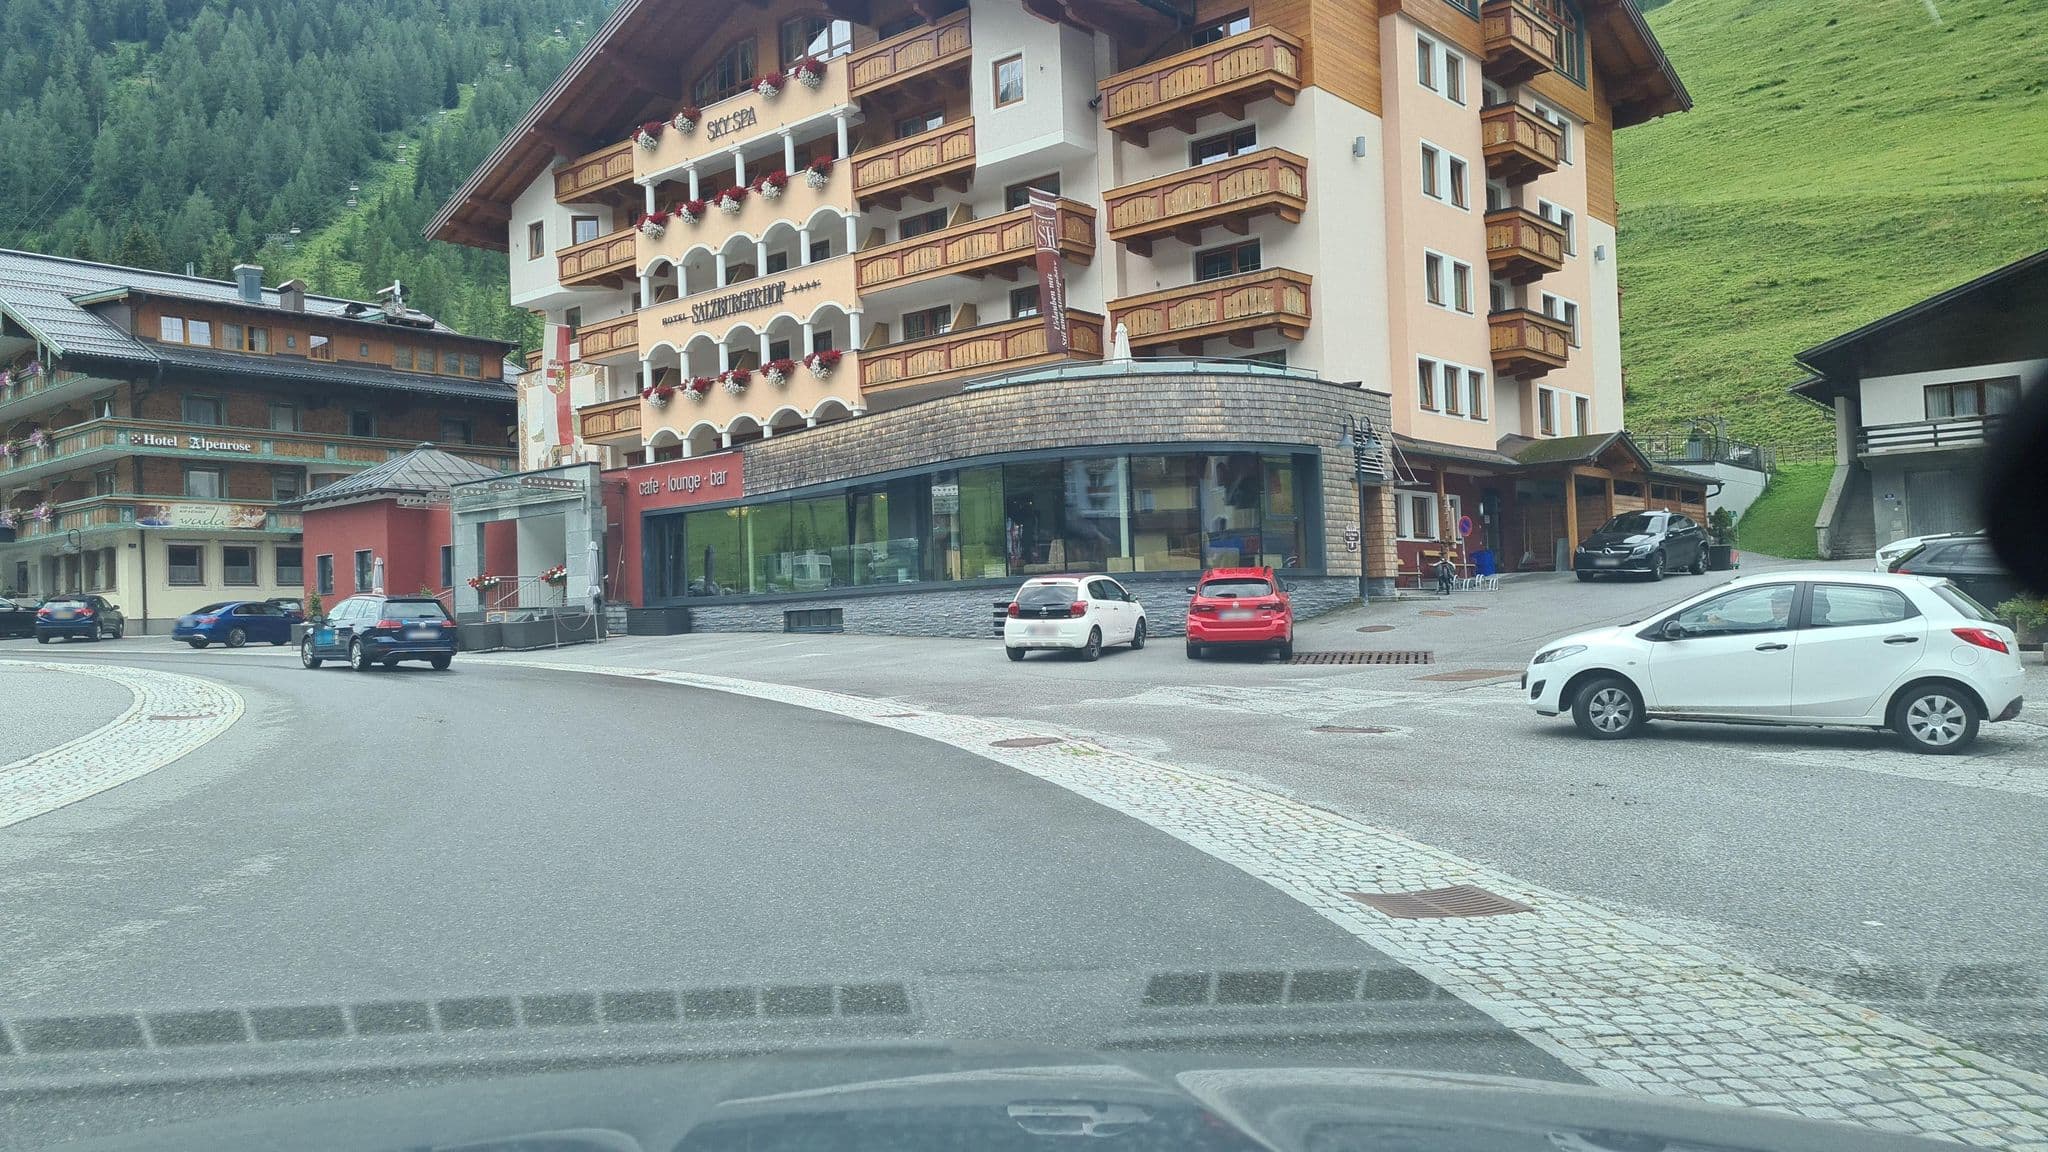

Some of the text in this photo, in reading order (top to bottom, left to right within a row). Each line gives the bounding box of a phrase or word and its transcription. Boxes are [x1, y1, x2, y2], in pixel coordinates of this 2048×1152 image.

[707, 106, 757, 140] SKY SPA
[1038, 225, 1056, 248] SH
[662, 281, 787, 326] HOTEL SALZBURGERHOF
[144, 434, 251, 451] Hotel Alpenrose
[639, 469, 728, 495] cafe lounge bar
